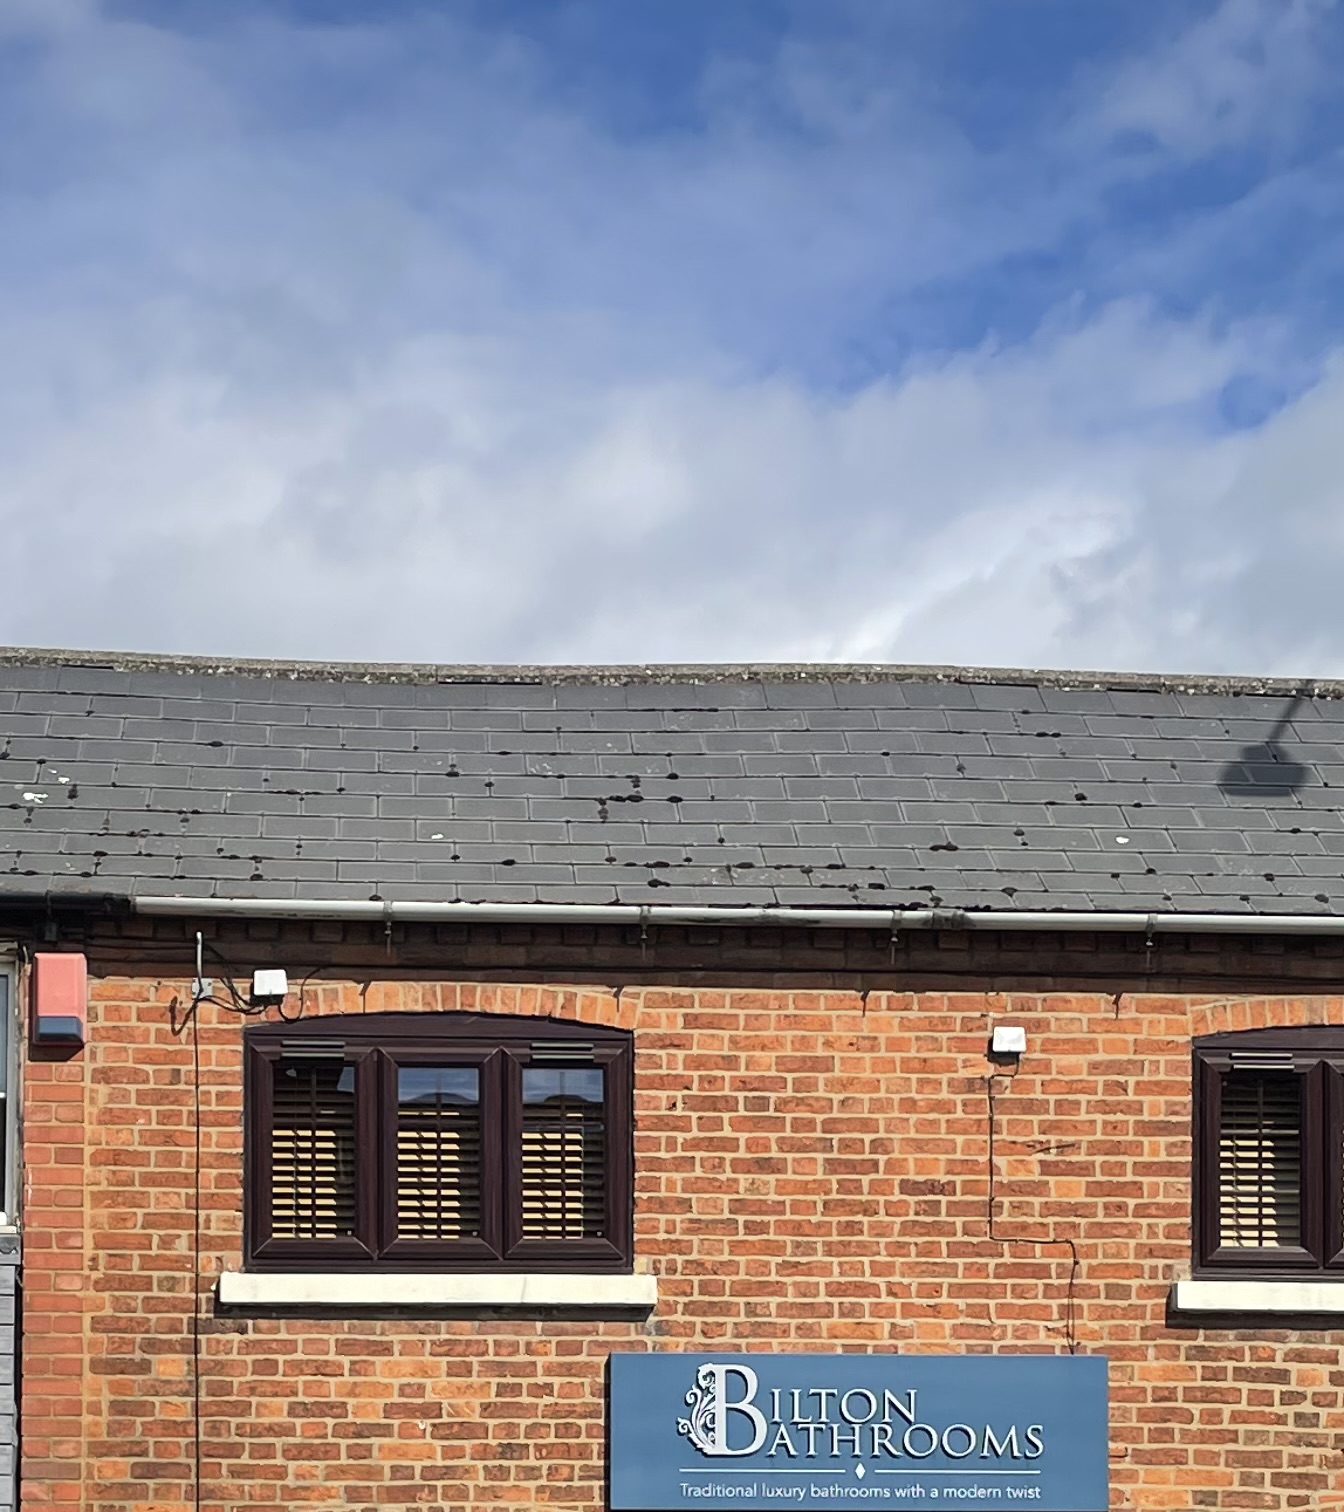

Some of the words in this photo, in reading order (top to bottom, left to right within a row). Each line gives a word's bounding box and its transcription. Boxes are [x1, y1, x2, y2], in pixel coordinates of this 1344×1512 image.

[711, 1363, 918, 1457] BILTON
[679, 1482, 757, 1499] Traditional
[761, 1483, 807, 1502] luxury
[810, 1483, 891, 1499] bathrooms
[894, 1483, 925, 1499] with
[929, 1488, 940, 1499] a
[943, 1483, 1002, 1499] modern
[1005, 1484, 1042, 1499] twist
